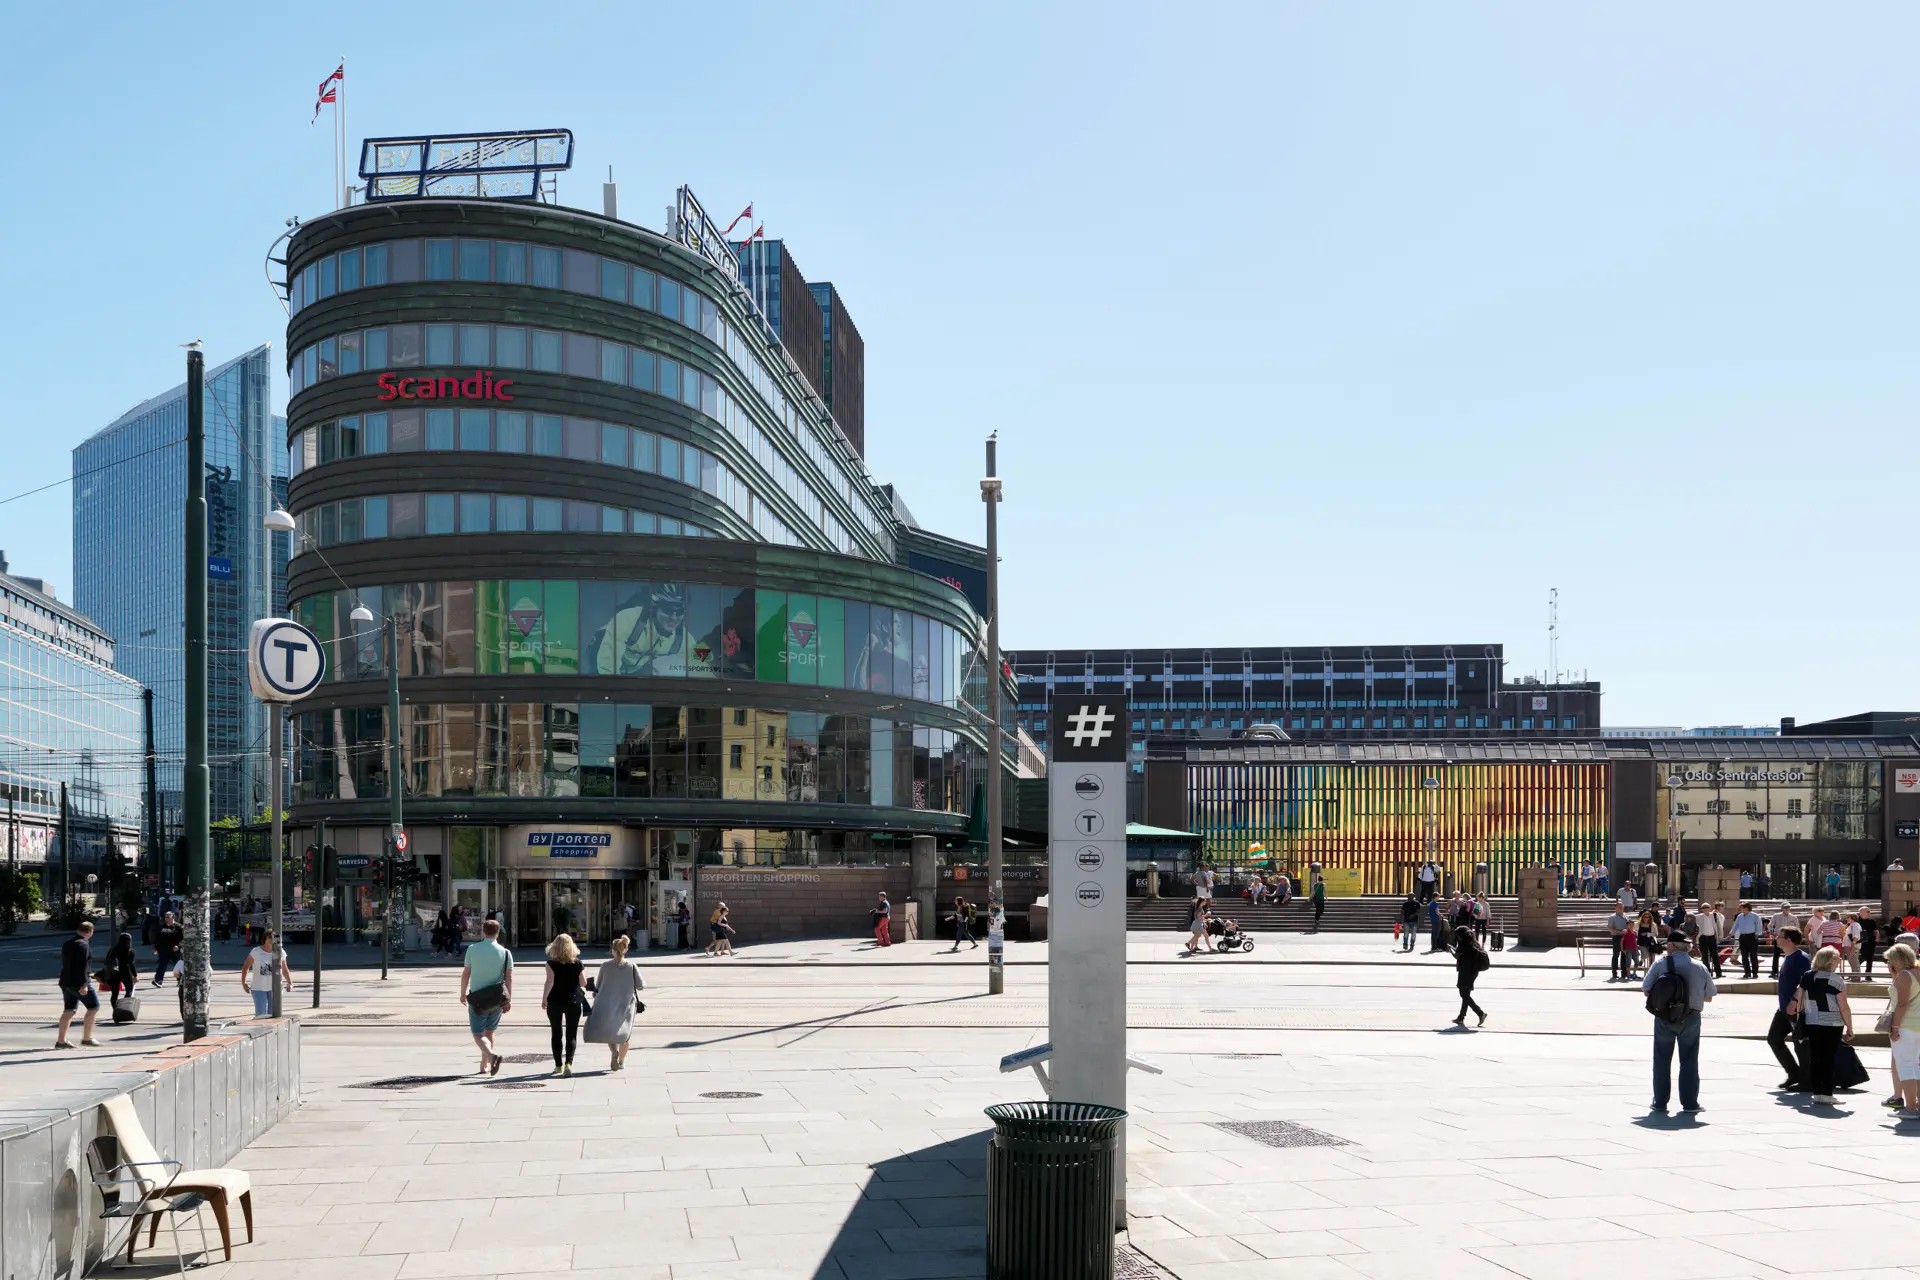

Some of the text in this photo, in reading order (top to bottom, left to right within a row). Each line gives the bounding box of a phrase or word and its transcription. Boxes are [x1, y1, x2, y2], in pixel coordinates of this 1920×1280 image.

[377, 370, 514, 400] Scandic
[210, 564, 231, 573] BLU
[498, 640, 555, 655] SPORT
[273, 638, 308, 683] T
[778, 651, 827, 668] SPORT
[1685, 769, 1806, 784] Oslo Sentralstasjon
[1082, 815, 1097, 833] T
[532, 835, 548, 844] BY
[554, 848, 594, 856] shopping
[701, 873, 821, 883] BYPORTEN SHOPPING
[971, 869, 1032, 879] Jernetorget
